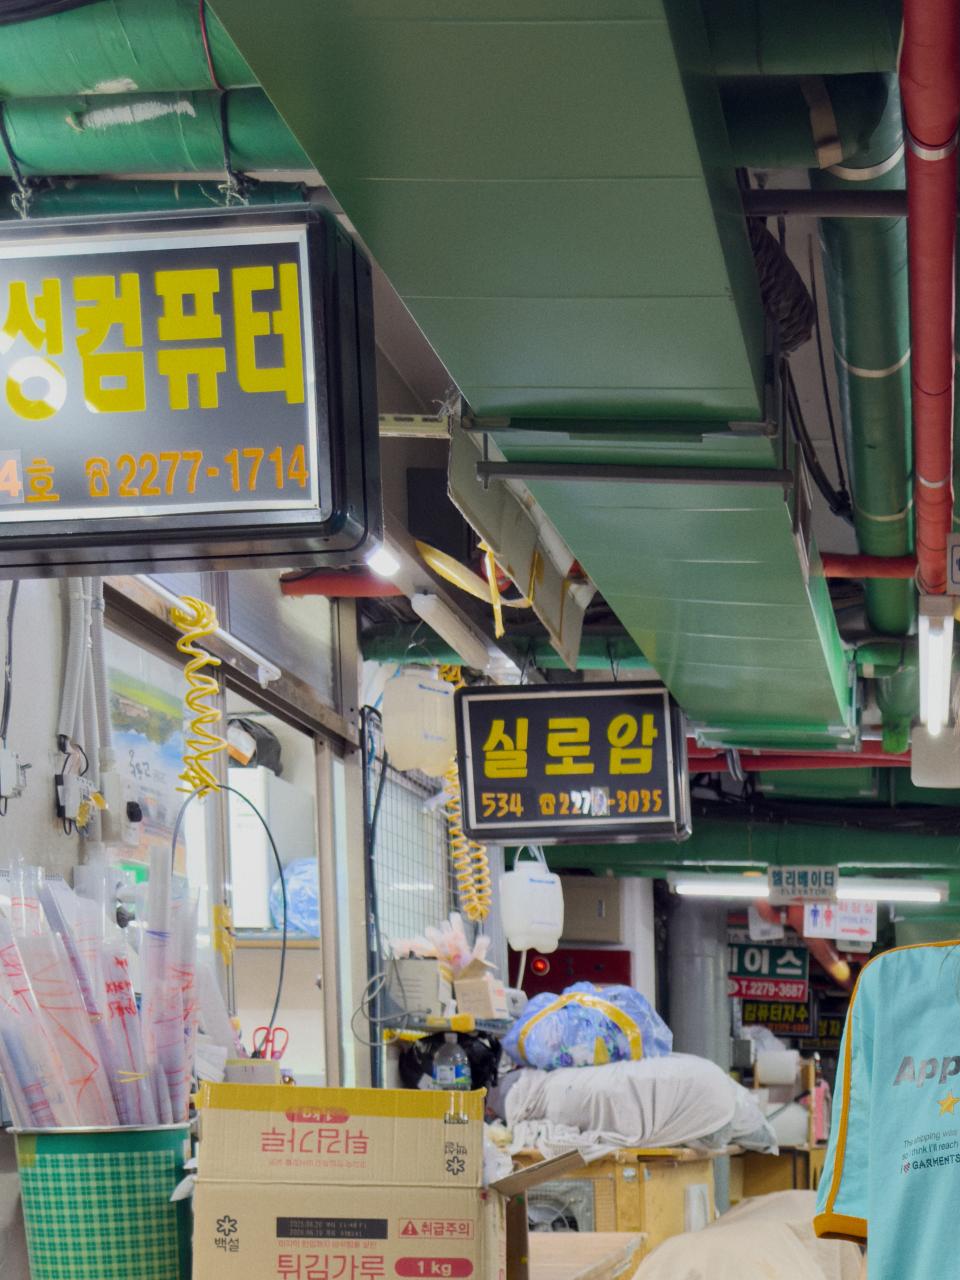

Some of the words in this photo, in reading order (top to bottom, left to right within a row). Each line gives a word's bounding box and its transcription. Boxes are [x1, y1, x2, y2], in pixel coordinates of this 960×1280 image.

[0, 263, 305, 421] 성컴퓨터
[117, 445, 309, 497] 2277-1714
[483, 714, 658, 779] 실로암
[481, 792, 524, 817] 534
[772, 870, 834, 887] 엘리베이터
[260, 1127, 369, 1155] 튀김가루
[939, 1139, 960, 1151] reach
[420, 1221, 471, 1237] 취급주의
[213, 1237, 240, 1252] 백설
[416, 1260, 425, 1275] 1
[431, 1259, 452, 1278] kg
